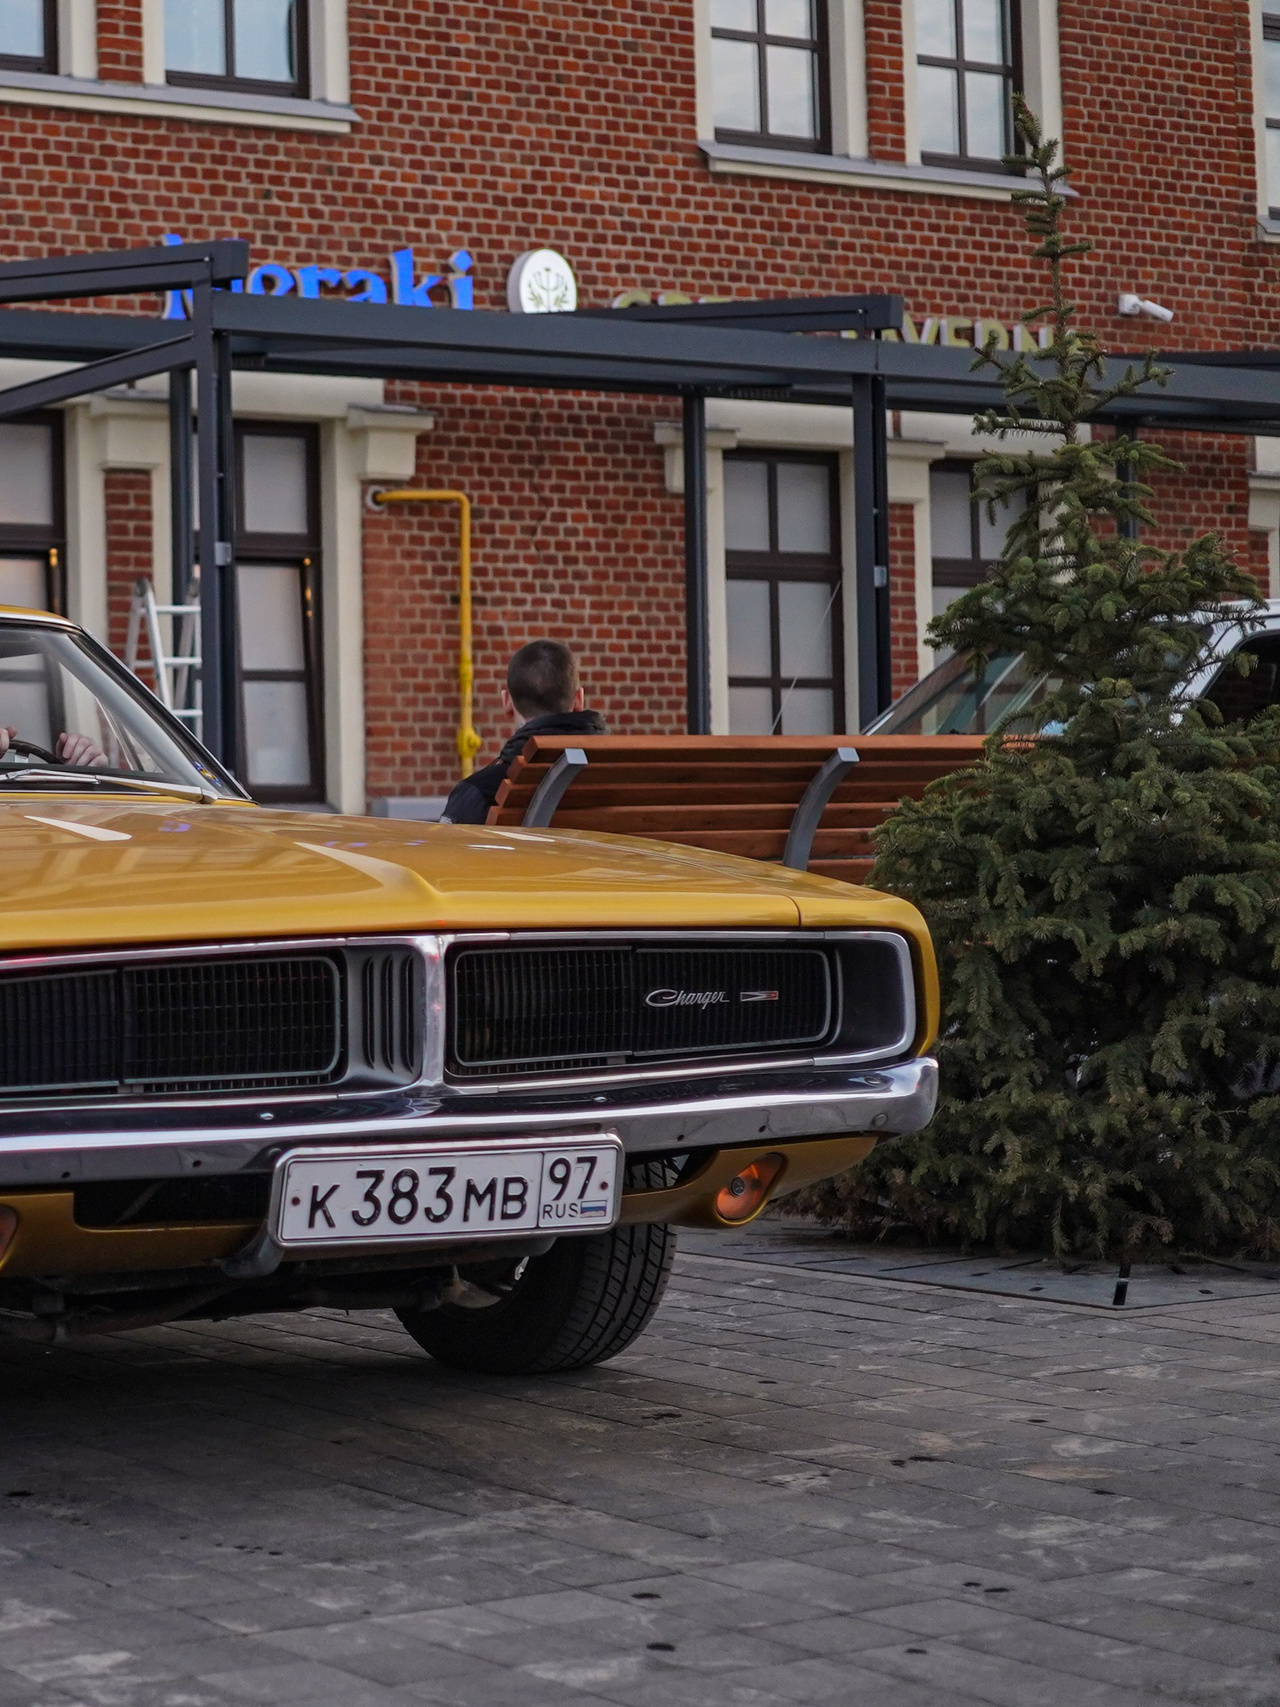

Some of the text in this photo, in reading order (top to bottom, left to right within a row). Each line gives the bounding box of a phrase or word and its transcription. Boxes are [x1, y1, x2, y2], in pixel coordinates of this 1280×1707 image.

[160, 233, 473, 320] eraki
[646, 989, 730, 1010] Charger
[549, 1156, 598, 1201] 97
[542, 1201, 580, 1219] RUS
